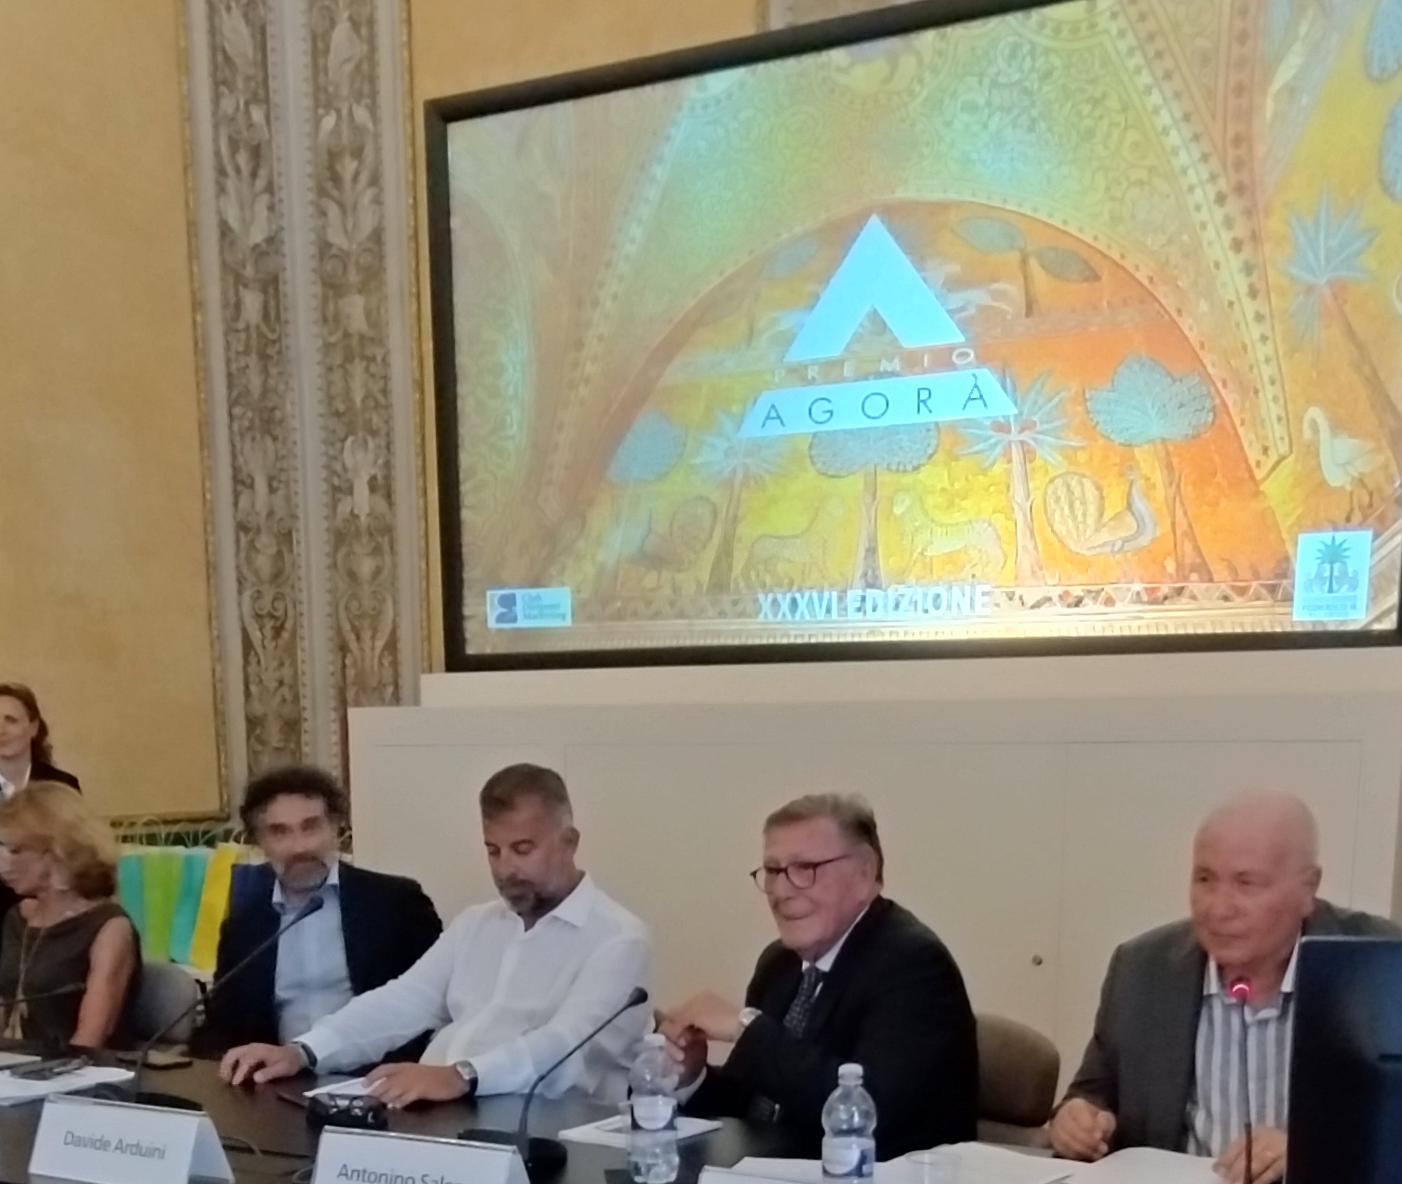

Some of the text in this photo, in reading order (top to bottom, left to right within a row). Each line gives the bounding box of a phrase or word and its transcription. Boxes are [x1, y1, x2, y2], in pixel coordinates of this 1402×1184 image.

[774, 348, 975, 383] PREMIO
[760, 373, 988, 429] AGORÀ
[757, 584, 992, 622] XXXVI EDIZIONE
[63, 1130, 167, 1161] Davide Arduini
